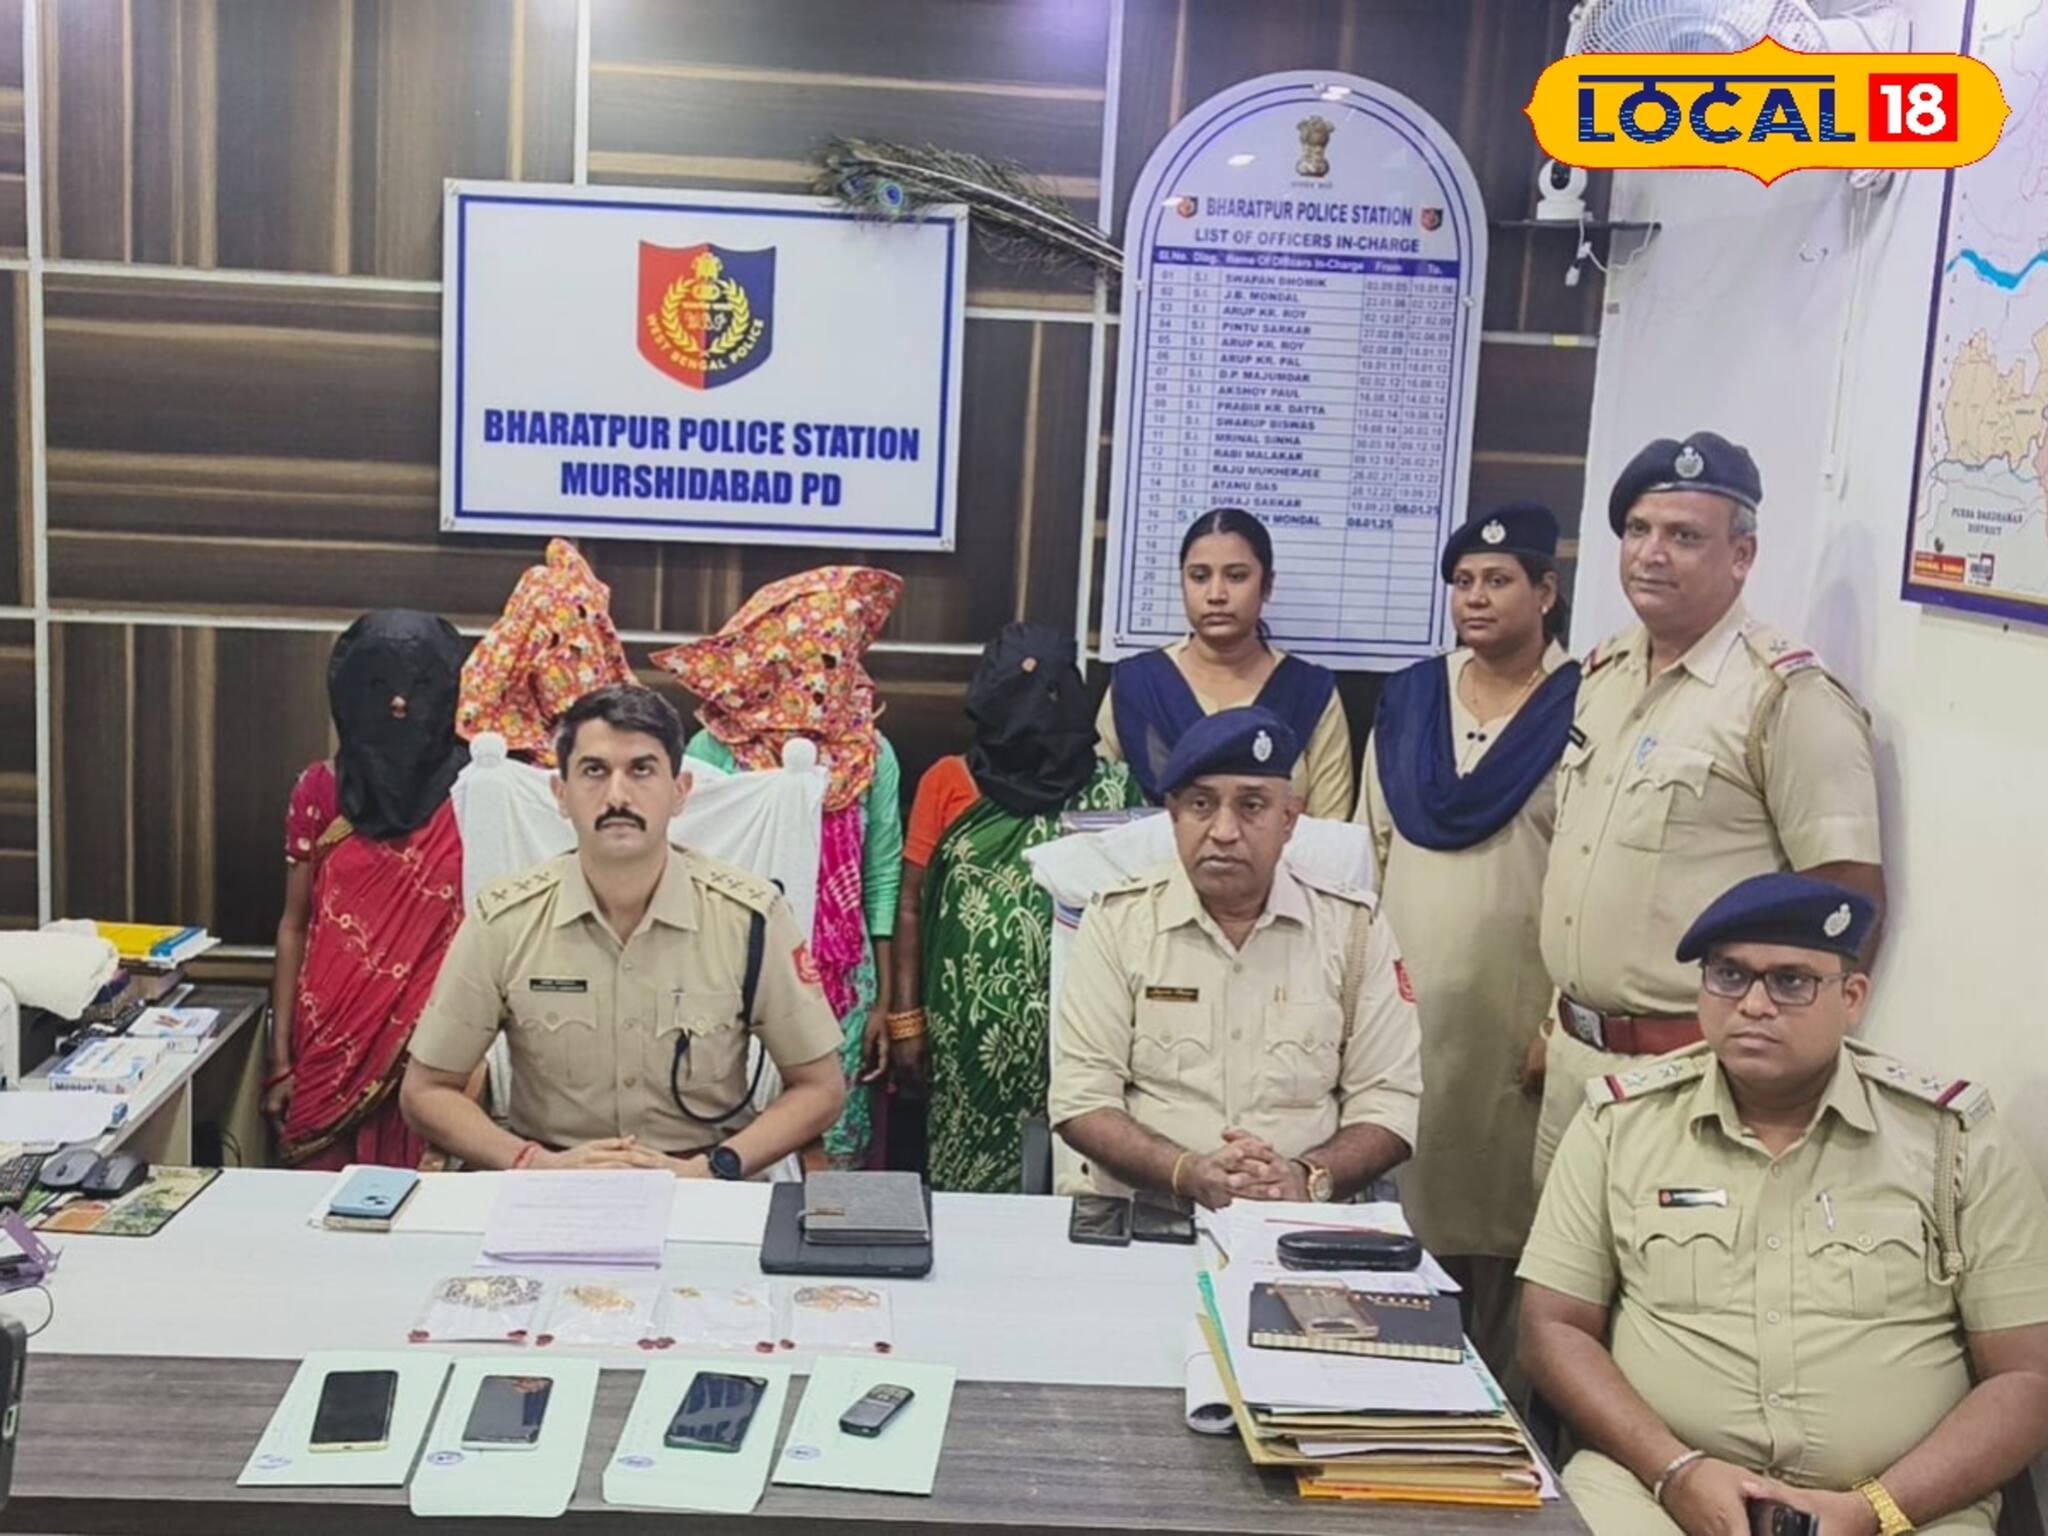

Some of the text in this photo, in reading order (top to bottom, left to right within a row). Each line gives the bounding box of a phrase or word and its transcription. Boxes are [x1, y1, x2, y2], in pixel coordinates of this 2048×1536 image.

[1206, 197, 1414, 227] BHARATPUR POLICE STATION
[1195, 228, 1420, 253] LIST OF OFFICERS IN-CHARGE
[1250, 292, 1299, 303] MONDAL
[1223, 306, 1256, 316] ARUP
[1222, 322, 1259, 332] PINTU
[1262, 324, 1311, 335] SARKAR
[646, 313, 765, 371] WEST BENGAL POLICE
[1221, 338, 1254, 348] ARUP
[1220, 354, 1253, 364] ARUP
[1243, 371, 1311, 383] MAJUMDAR
[1218, 386, 1267, 396] AKSHOY
[1270, 388, 1300, 398] PAUL
[1288, 405, 1326, 415] DATTA
[1216, 417, 1267, 428] SWARUP
[1270, 419, 1316, 430] BISWAS
[483, 409, 921, 462] BHARATPUR POLICE STATION
[1215, 433, 1259, 444] MRINAL
[1265, 435, 1301, 445] SINHA
[1213, 449, 1242, 459] RABI
[1245, 450, 1303, 461] MALAKAR
[1213, 465, 1245, 475] RAJU
[1248, 466, 1320, 478] MUKHERJEE
[560, 462, 842, 506] MURSHIDABAD PD
[1211, 481, 1251, 490] ATANU
[1211, 496, 1249, 506] SURAJ
[1254, 497, 1302, 508] SARKAR
[1272, 513, 1321, 526] MONDAL
